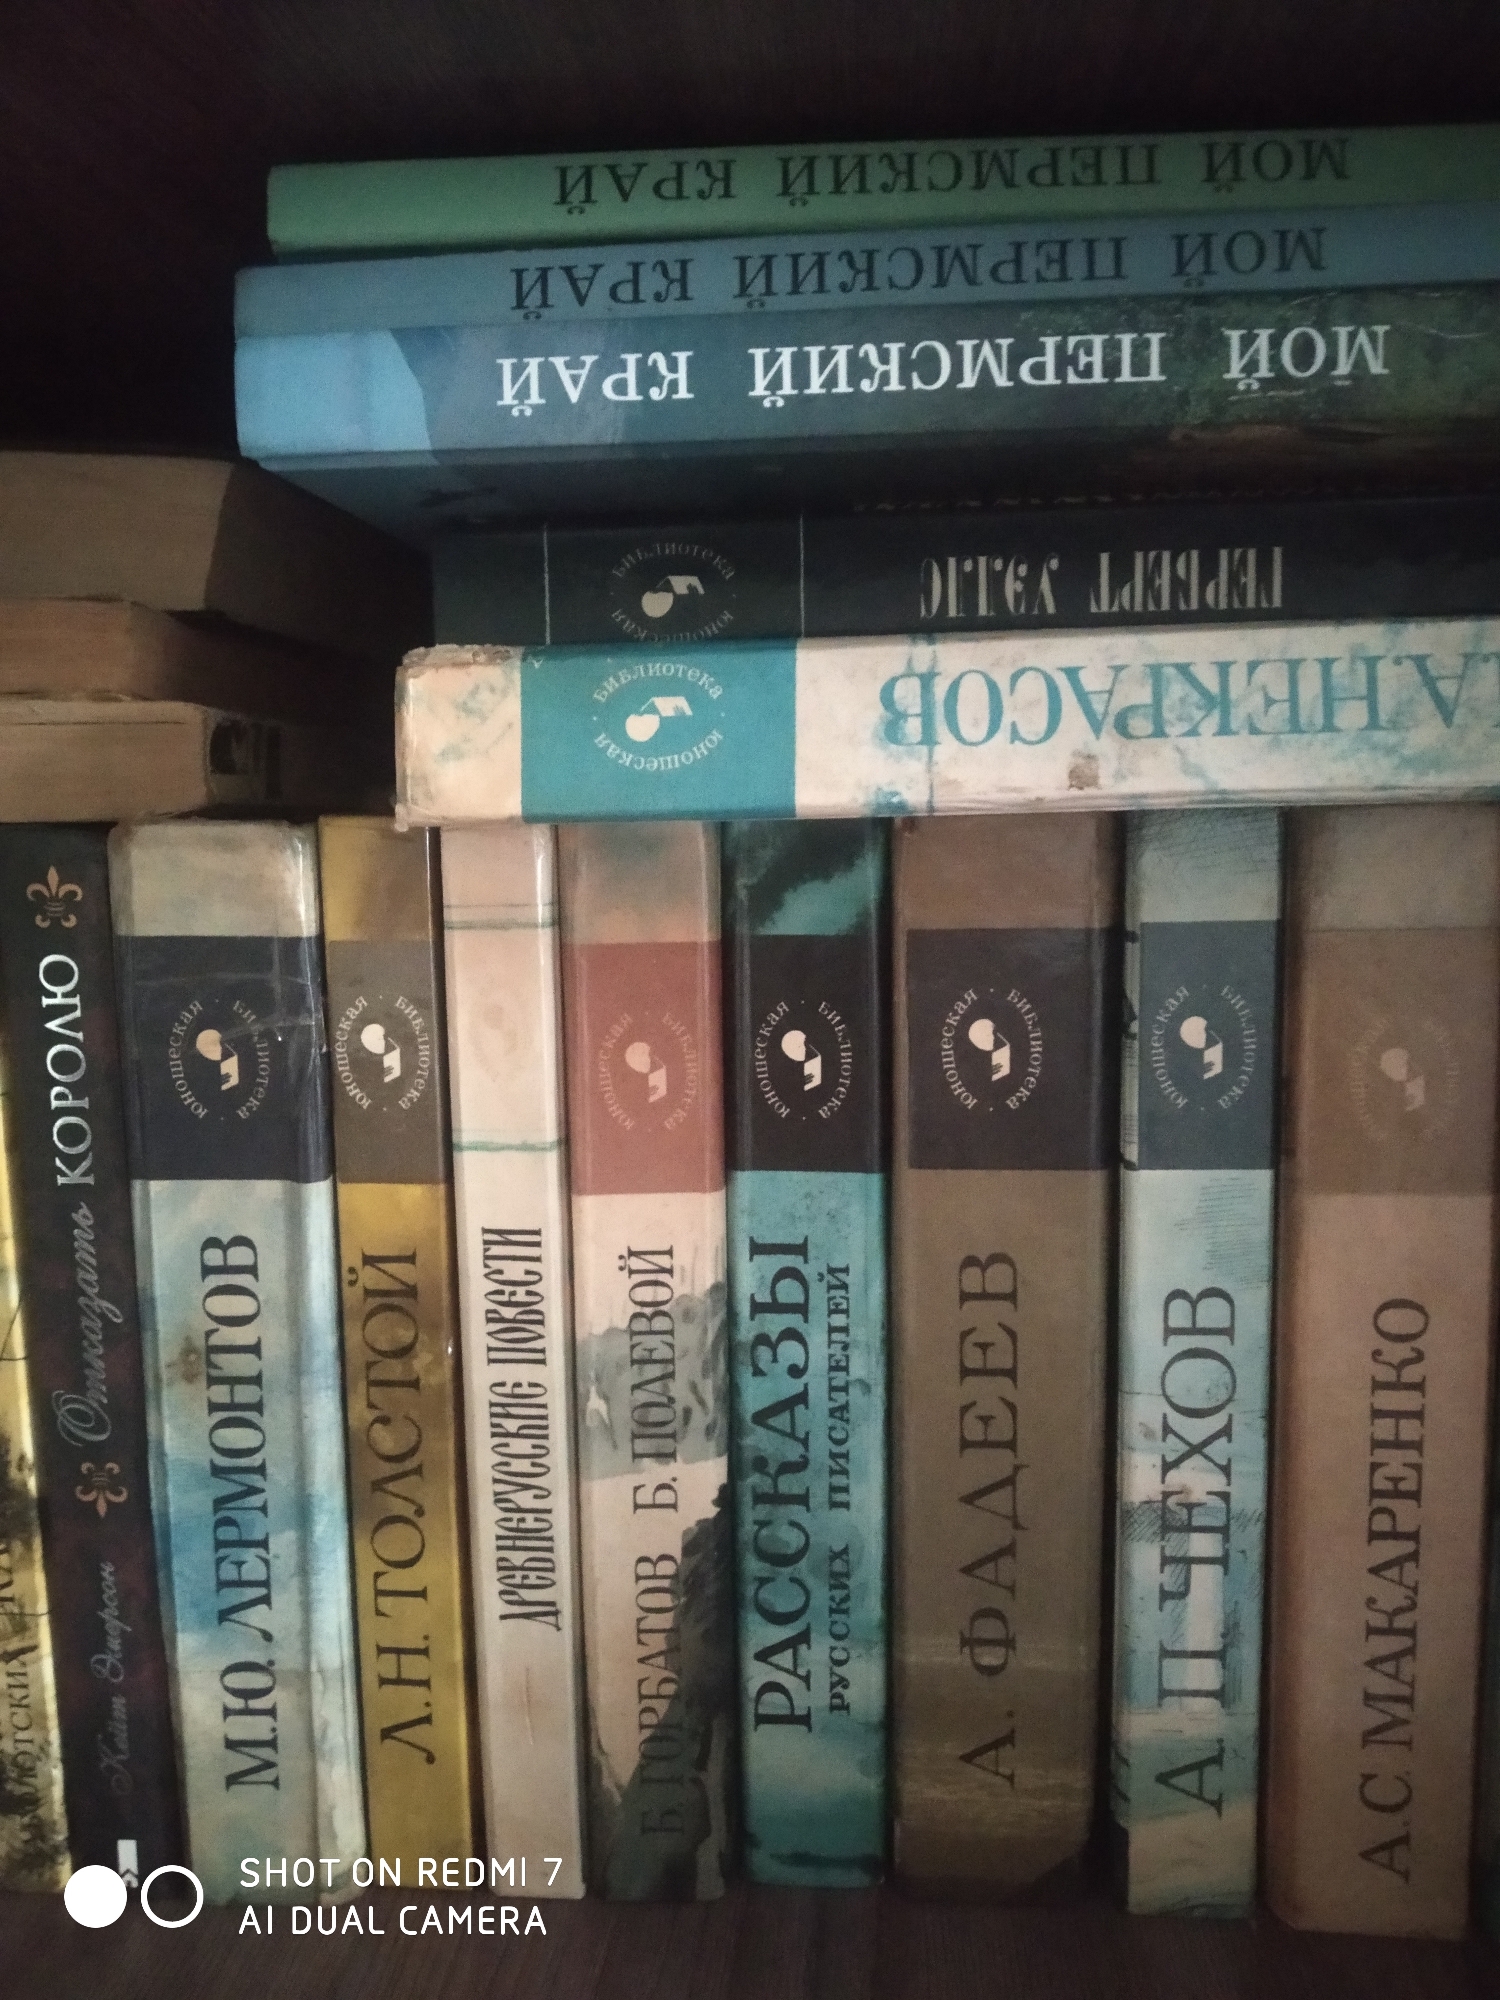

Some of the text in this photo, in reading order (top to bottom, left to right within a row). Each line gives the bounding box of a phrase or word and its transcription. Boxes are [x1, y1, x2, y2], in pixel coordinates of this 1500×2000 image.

[510, 227, 1328, 320] МОЙ ПЕРМСКИЙ КРАЙ
[554, 137, 1350, 216] МОЙ ПЕРМСКИЙ КРАЙ
[496, 323, 1392, 417] МОЙ ПЕРМСКИЙ КРАЙ
[919, 545, 1284, 619] ГЕРБЕРТ УЭЛЛС
[38, 953, 123, 1447] Отказать КОРОЛЮ
[617, 1243, 678, 1464] ПОЛЕВОЙ
[199, 1233, 274, 1643] ЛЕРМОНТОВ
[346, 1247, 428, 1618] ТОЛСТОЙ
[481, 1226, 562, 1632] ДРЕВНЕРУССКИЕ ПОВЕСТИ
[748, 1235, 812, 1732] РАССКАЗЫ
[816, 1264, 852, 1716] РУССКИХ ПИСАТЕЛЕЙ
[958, 1251, 1029, 1789] А. ФАДЕЕВ
[1158, 1285, 1238, 1612] ЧЕХОВ
[1361, 1297, 1430, 1751] МАКАРЕНКО
[635, 1552, 685, 1787] ГОРБАТОВ
